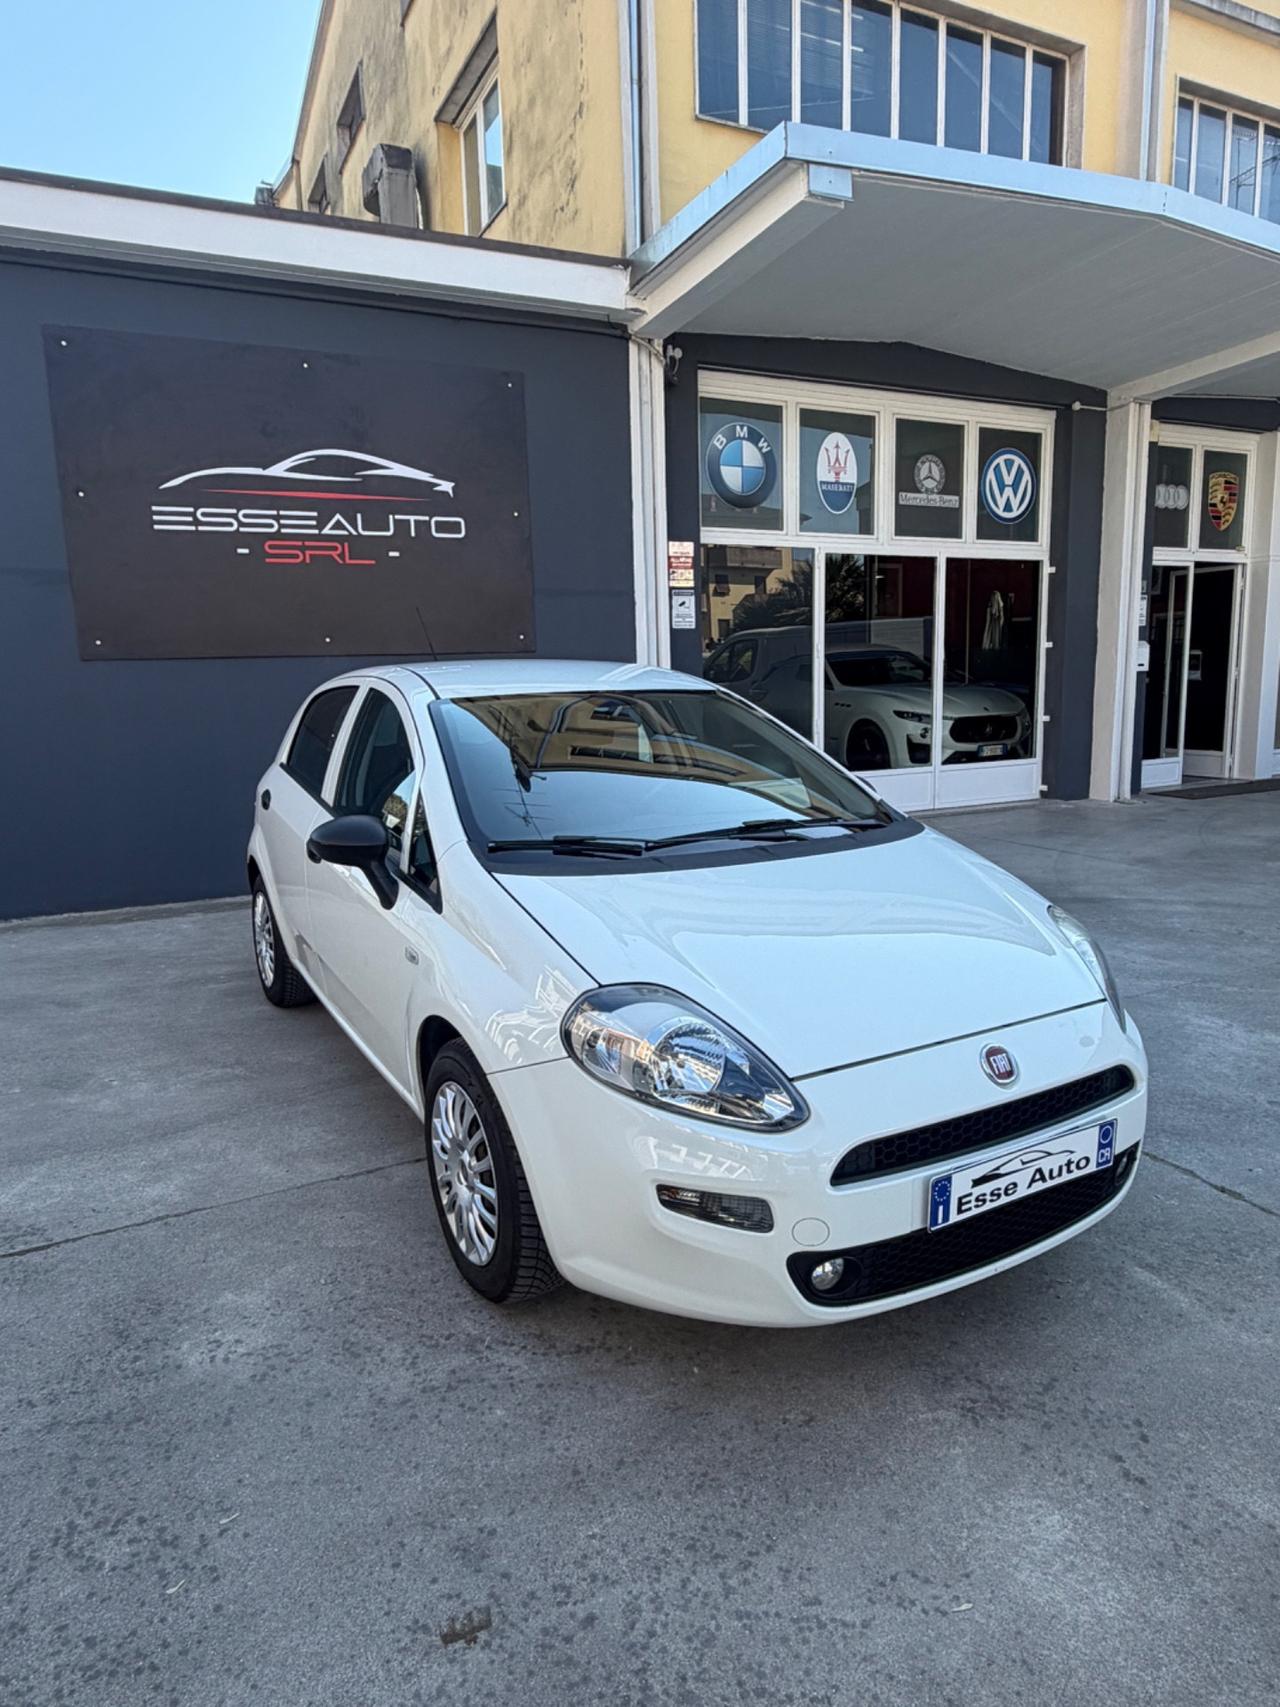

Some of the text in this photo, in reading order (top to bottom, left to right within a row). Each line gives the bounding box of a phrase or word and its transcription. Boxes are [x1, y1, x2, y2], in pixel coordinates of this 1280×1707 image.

[713, 425, 771, 453] BMW
[151, 505, 466, 538] ESSEAUTO
[264, 540, 376, 564] SRL
[990, 1053, 1011, 1075] FIAT
[956, 1155, 1091, 1216] Esse Auto
